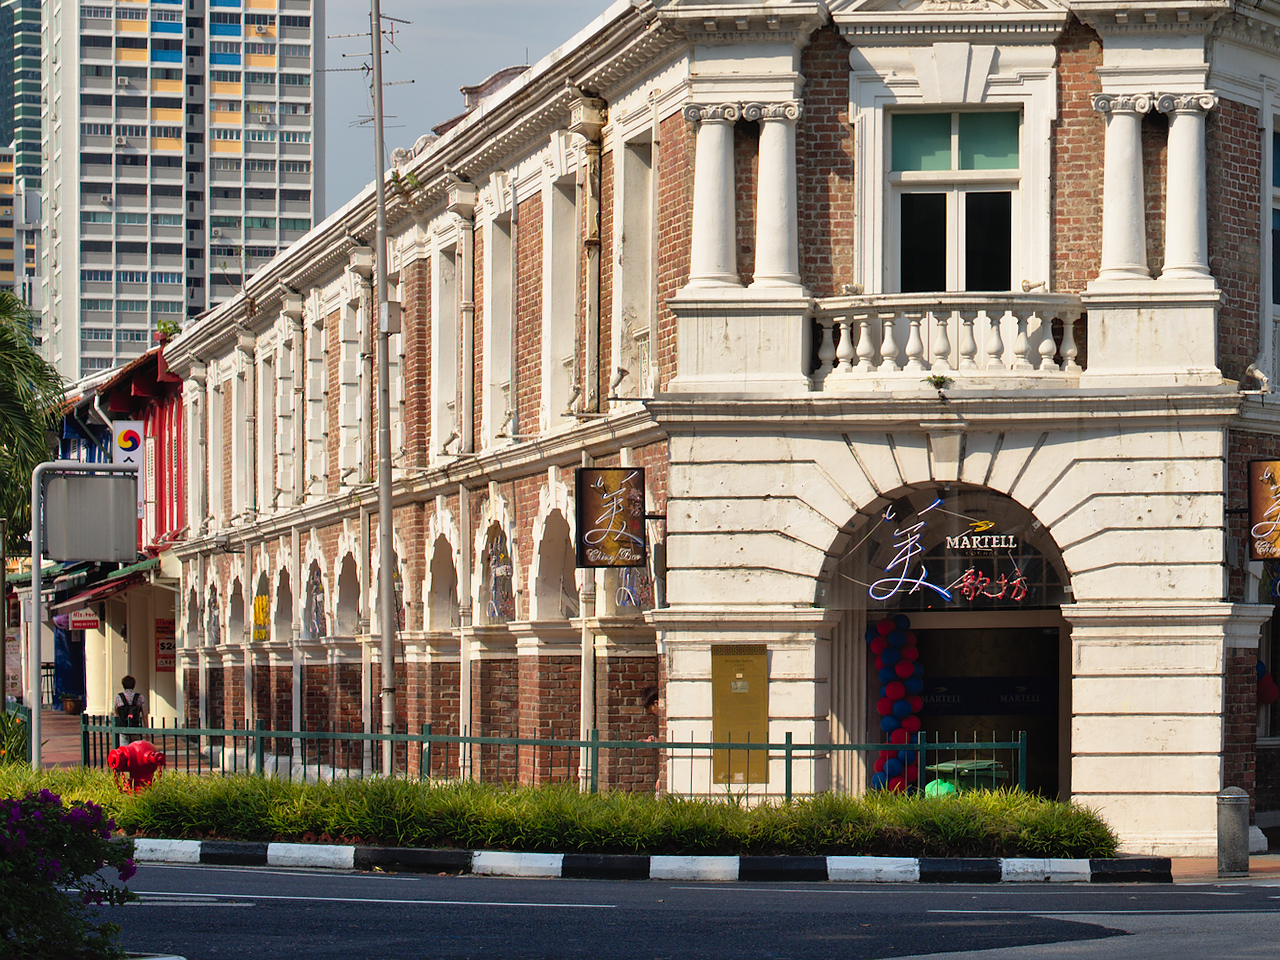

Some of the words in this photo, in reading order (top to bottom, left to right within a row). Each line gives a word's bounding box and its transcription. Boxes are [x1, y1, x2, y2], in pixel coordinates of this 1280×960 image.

[945, 535, 1017, 551] MARTELL
[585, 548, 615, 565] Ching
[619, 547, 642, 560] Bar
[954, 566, 1029, 602] 歌坊
[920, 695, 962, 703] MARTELL
[1000, 694, 1041, 702] MARTELL
